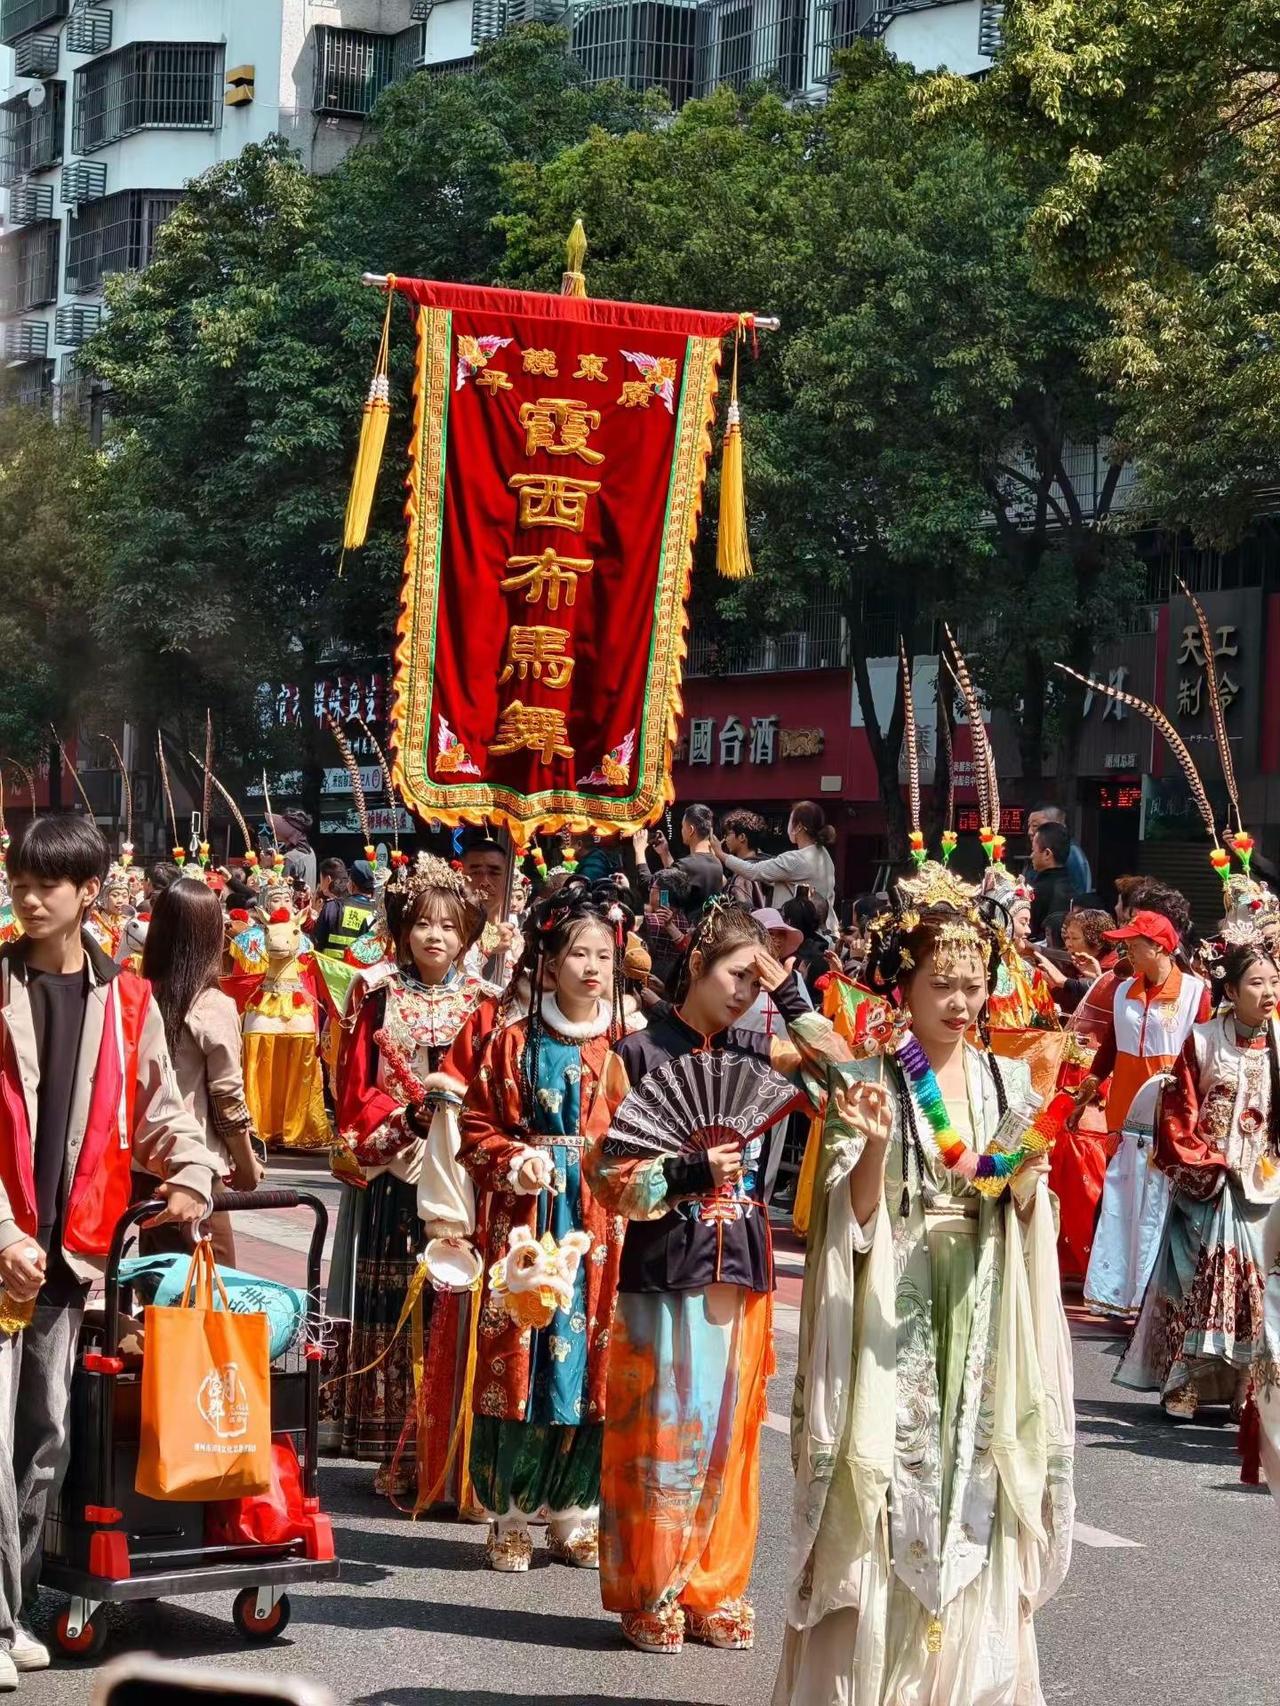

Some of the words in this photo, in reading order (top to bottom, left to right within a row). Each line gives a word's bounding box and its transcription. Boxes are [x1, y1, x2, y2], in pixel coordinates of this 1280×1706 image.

[488, 397, 605, 766] 霞西布馬舞
[1176, 626, 1238, 666] 天工
